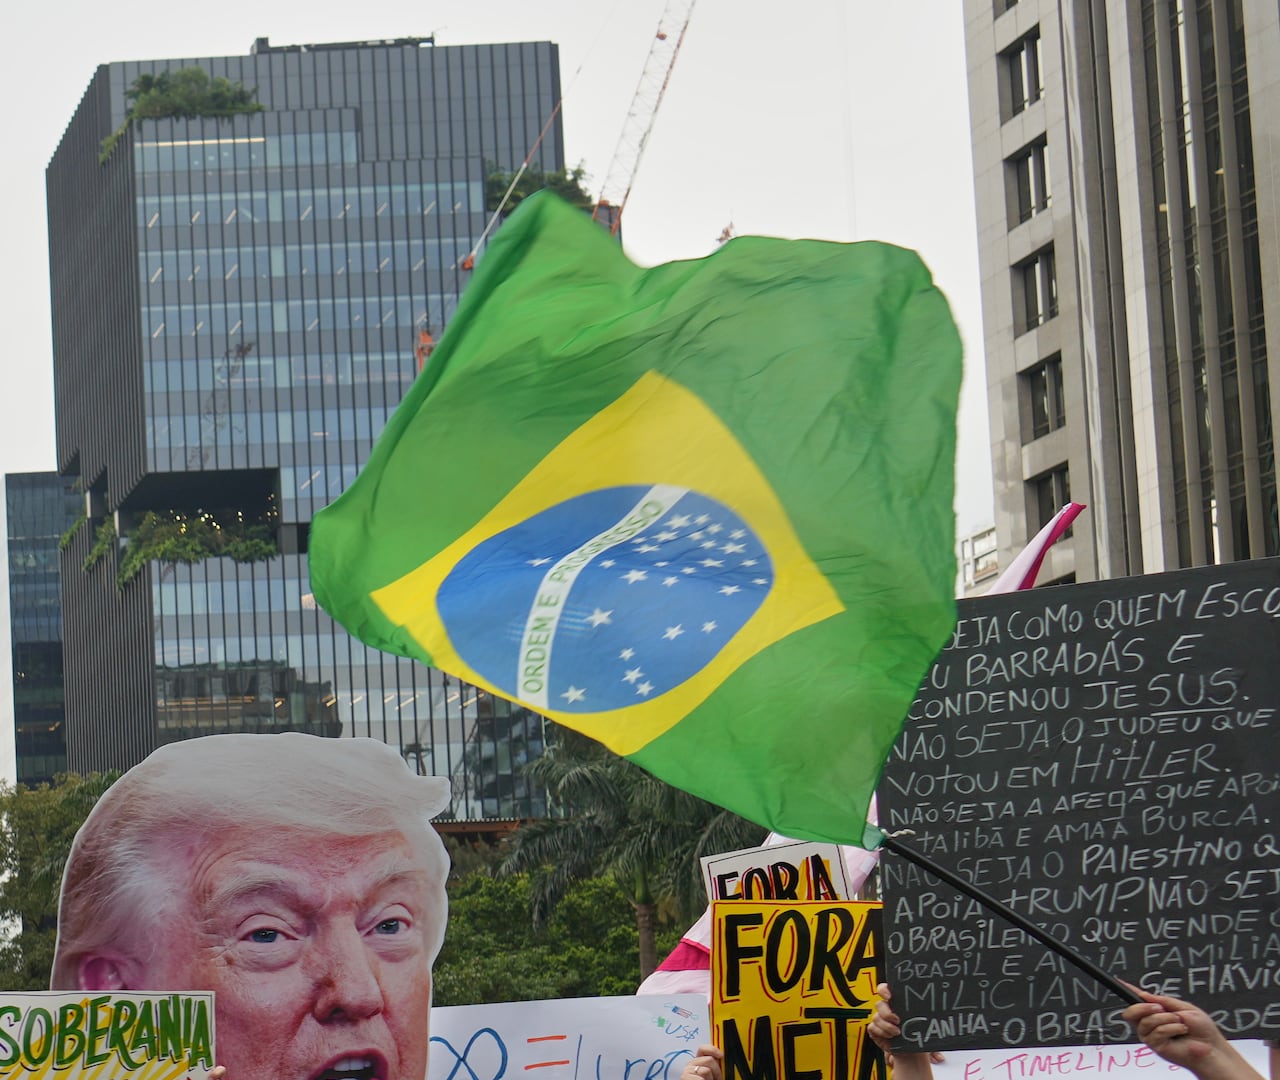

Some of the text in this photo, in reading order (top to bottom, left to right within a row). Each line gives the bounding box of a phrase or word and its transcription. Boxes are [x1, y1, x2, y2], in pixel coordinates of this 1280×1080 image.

[537, 594, 560, 608] E
[1008, 589, 1187, 640] COMO QUEM
[523, 615, 557, 694] ORDEM
[908, 686, 1070, 720] CONDENOU
[887, 709, 1276, 762] NÃO SEJA O JUDEU QUE
[888, 762, 1060, 797] VOTOU EM
[891, 801, 1015, 826] NÃO SEJA
[1042, 851, 1064, 879] O
[1148, 876, 1209, 913] NÃO
[1081, 909, 1261, 943] QUE VENDE
[725, 907, 887, 1007] FORA
